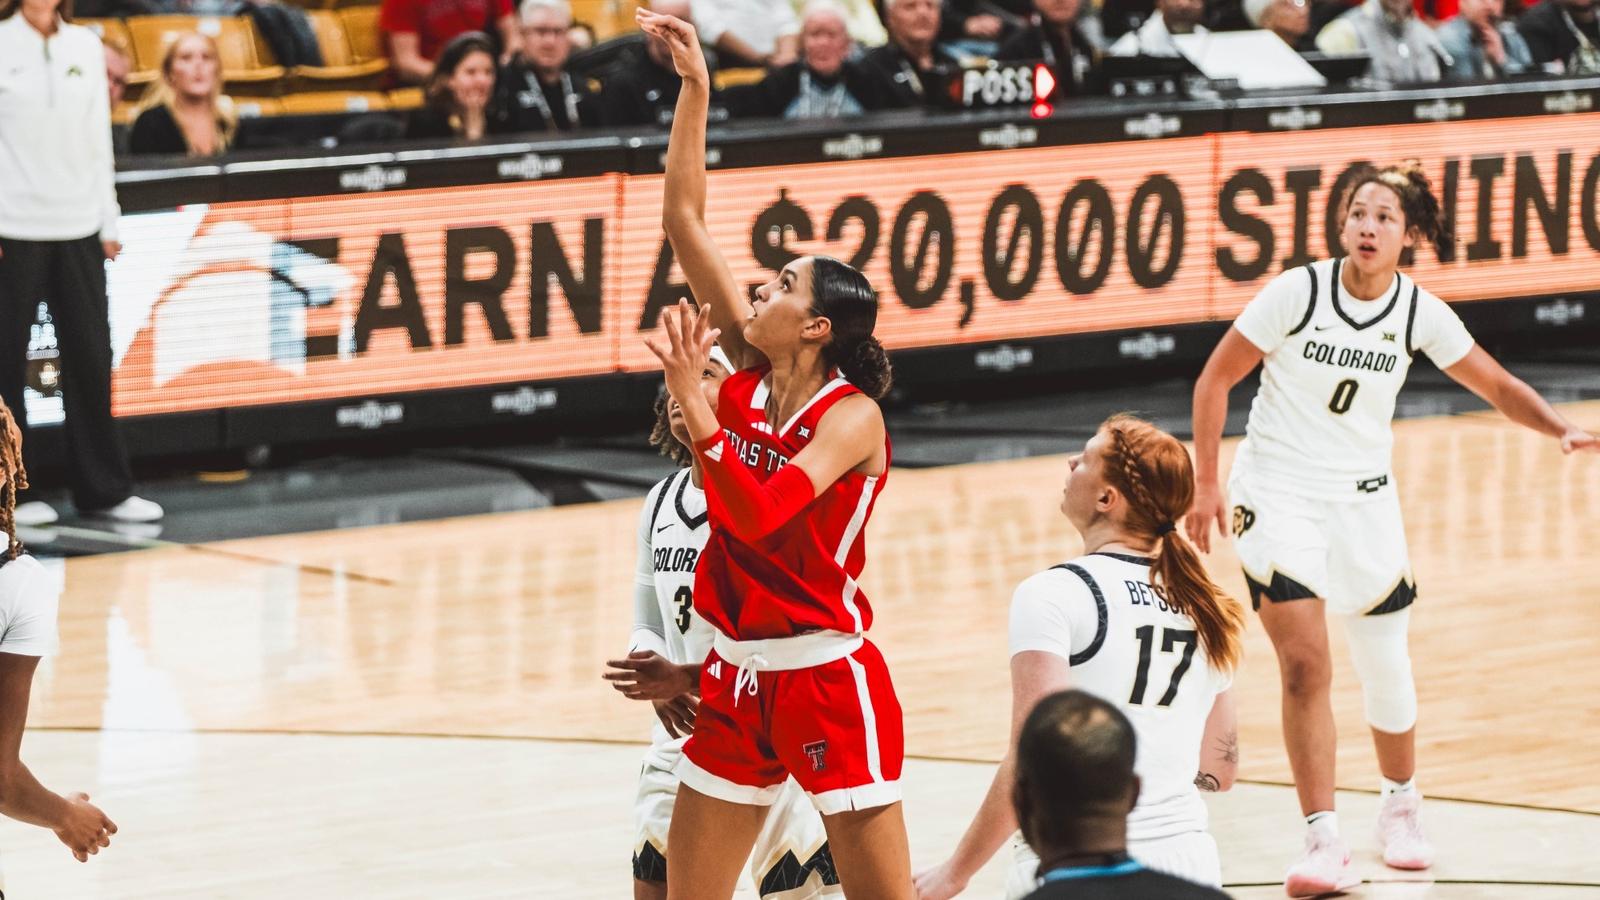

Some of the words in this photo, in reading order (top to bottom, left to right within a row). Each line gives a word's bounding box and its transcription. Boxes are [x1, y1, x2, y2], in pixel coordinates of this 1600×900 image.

[963, 66, 1033, 106] POSS
[750, 172, 1185, 329] $20,000
[1303, 340, 1398, 373] COLORADO
[1328, 378, 1360, 415] 0
[673, 585, 693, 635] 3
[1128, 624, 1198, 707] 17
